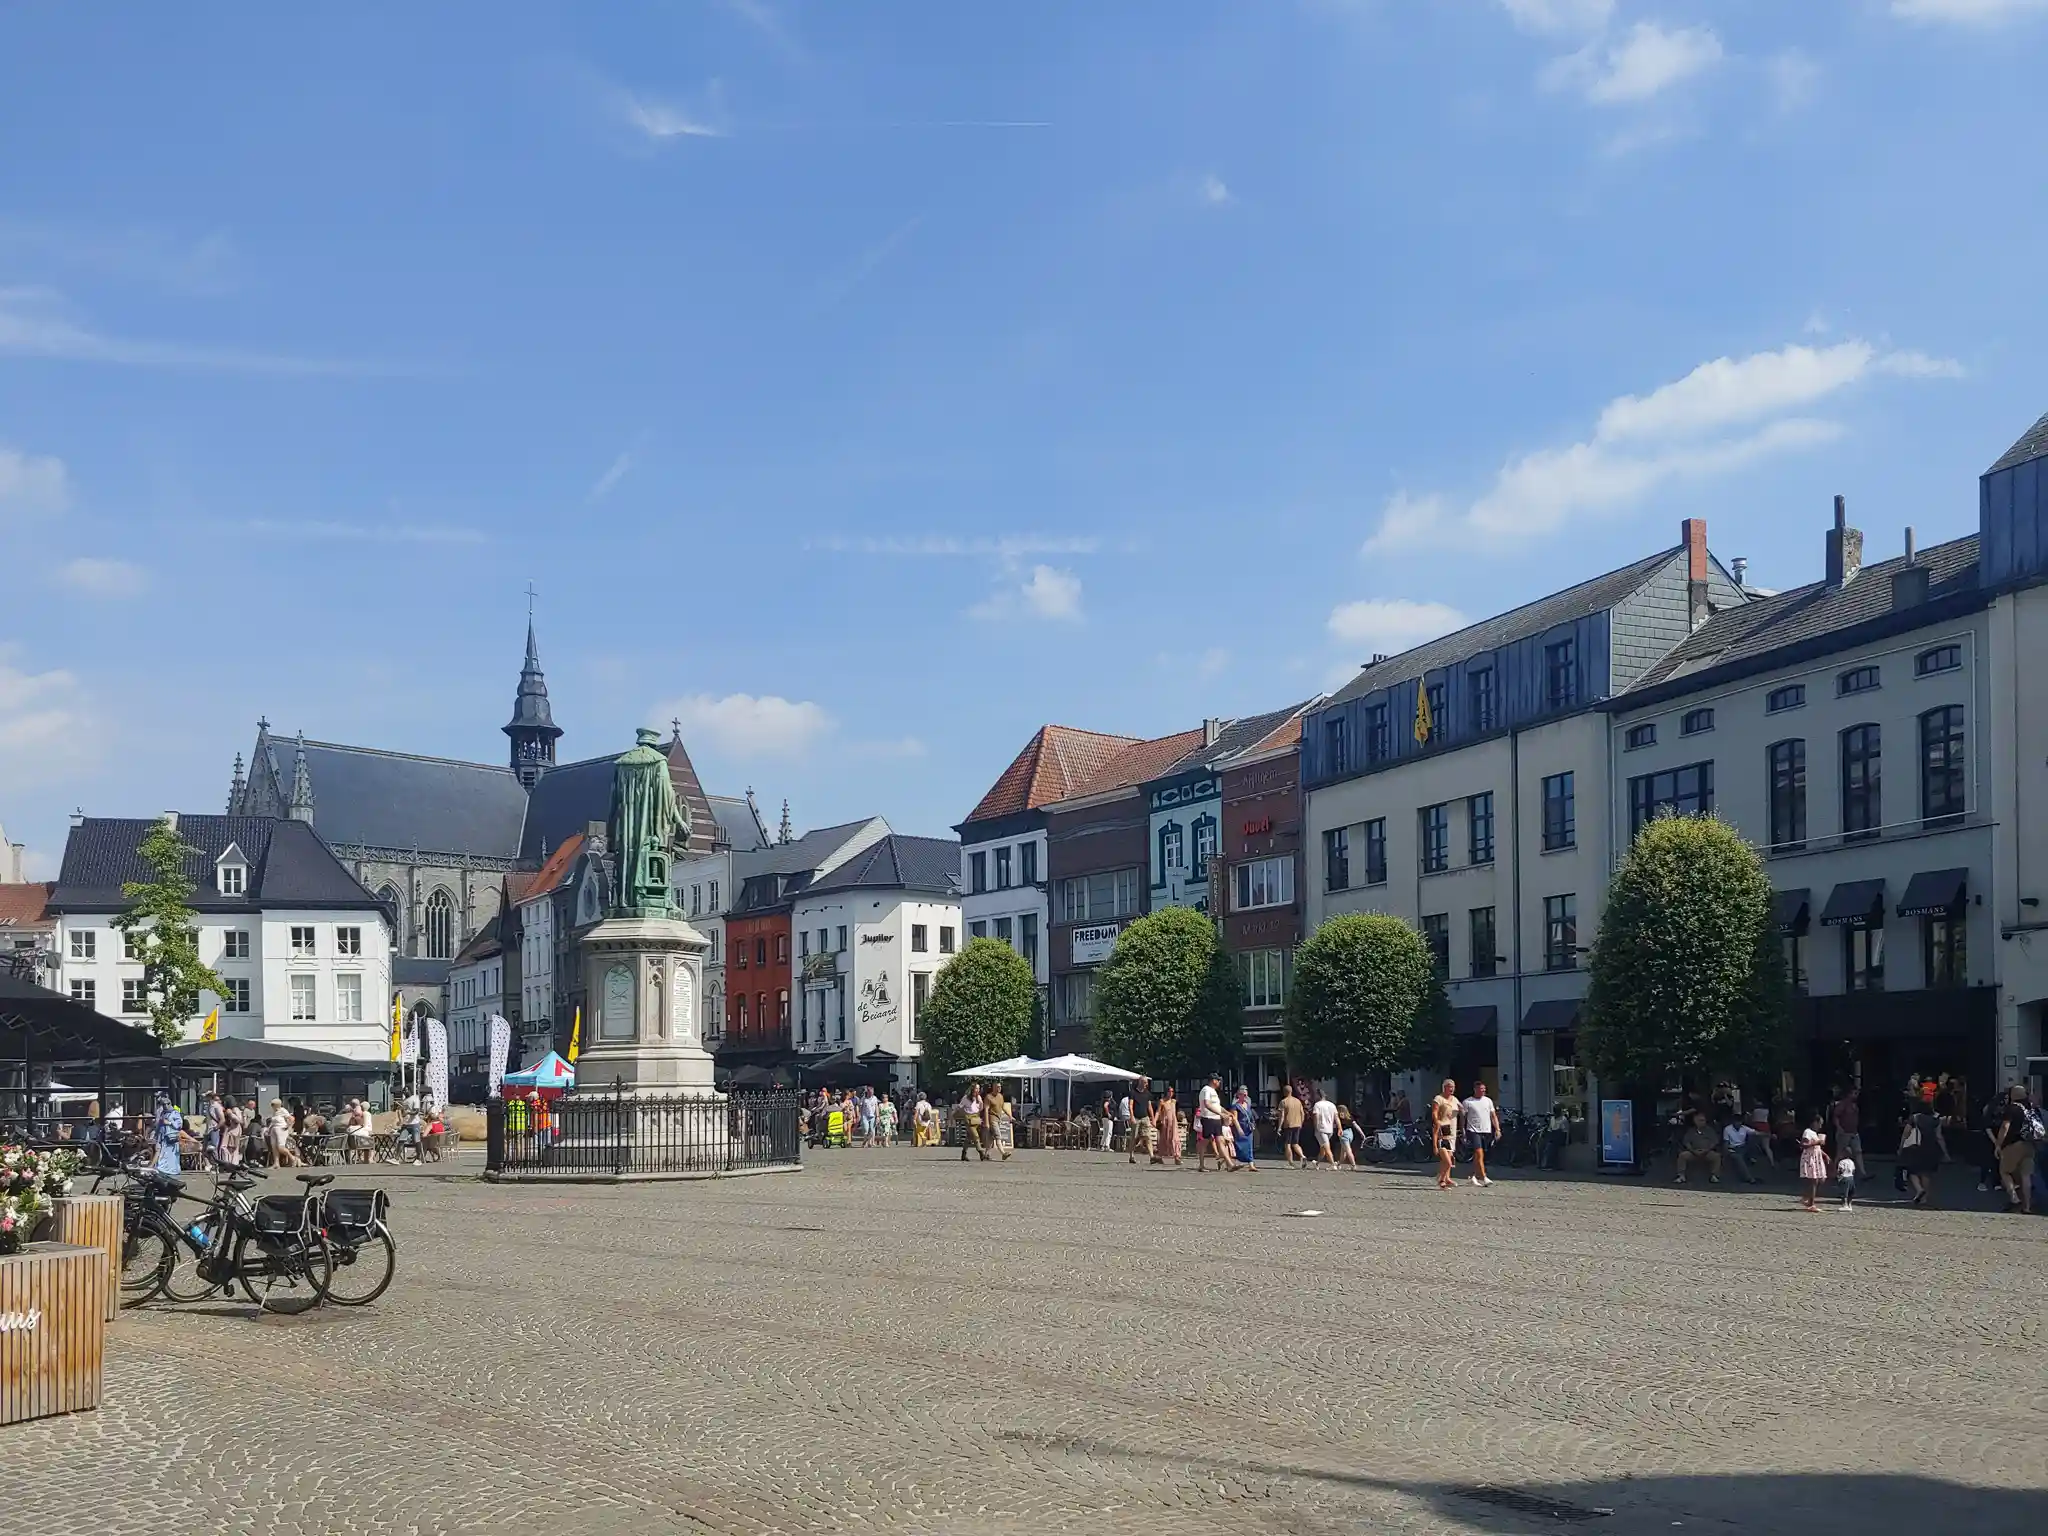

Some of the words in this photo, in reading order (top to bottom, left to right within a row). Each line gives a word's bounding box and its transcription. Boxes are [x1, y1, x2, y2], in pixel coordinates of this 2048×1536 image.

[1905, 905, 1944, 916] BOSMANS
[1827, 914, 1863, 926] BOSMANS
[860, 933, 894, 946] Jupiler
